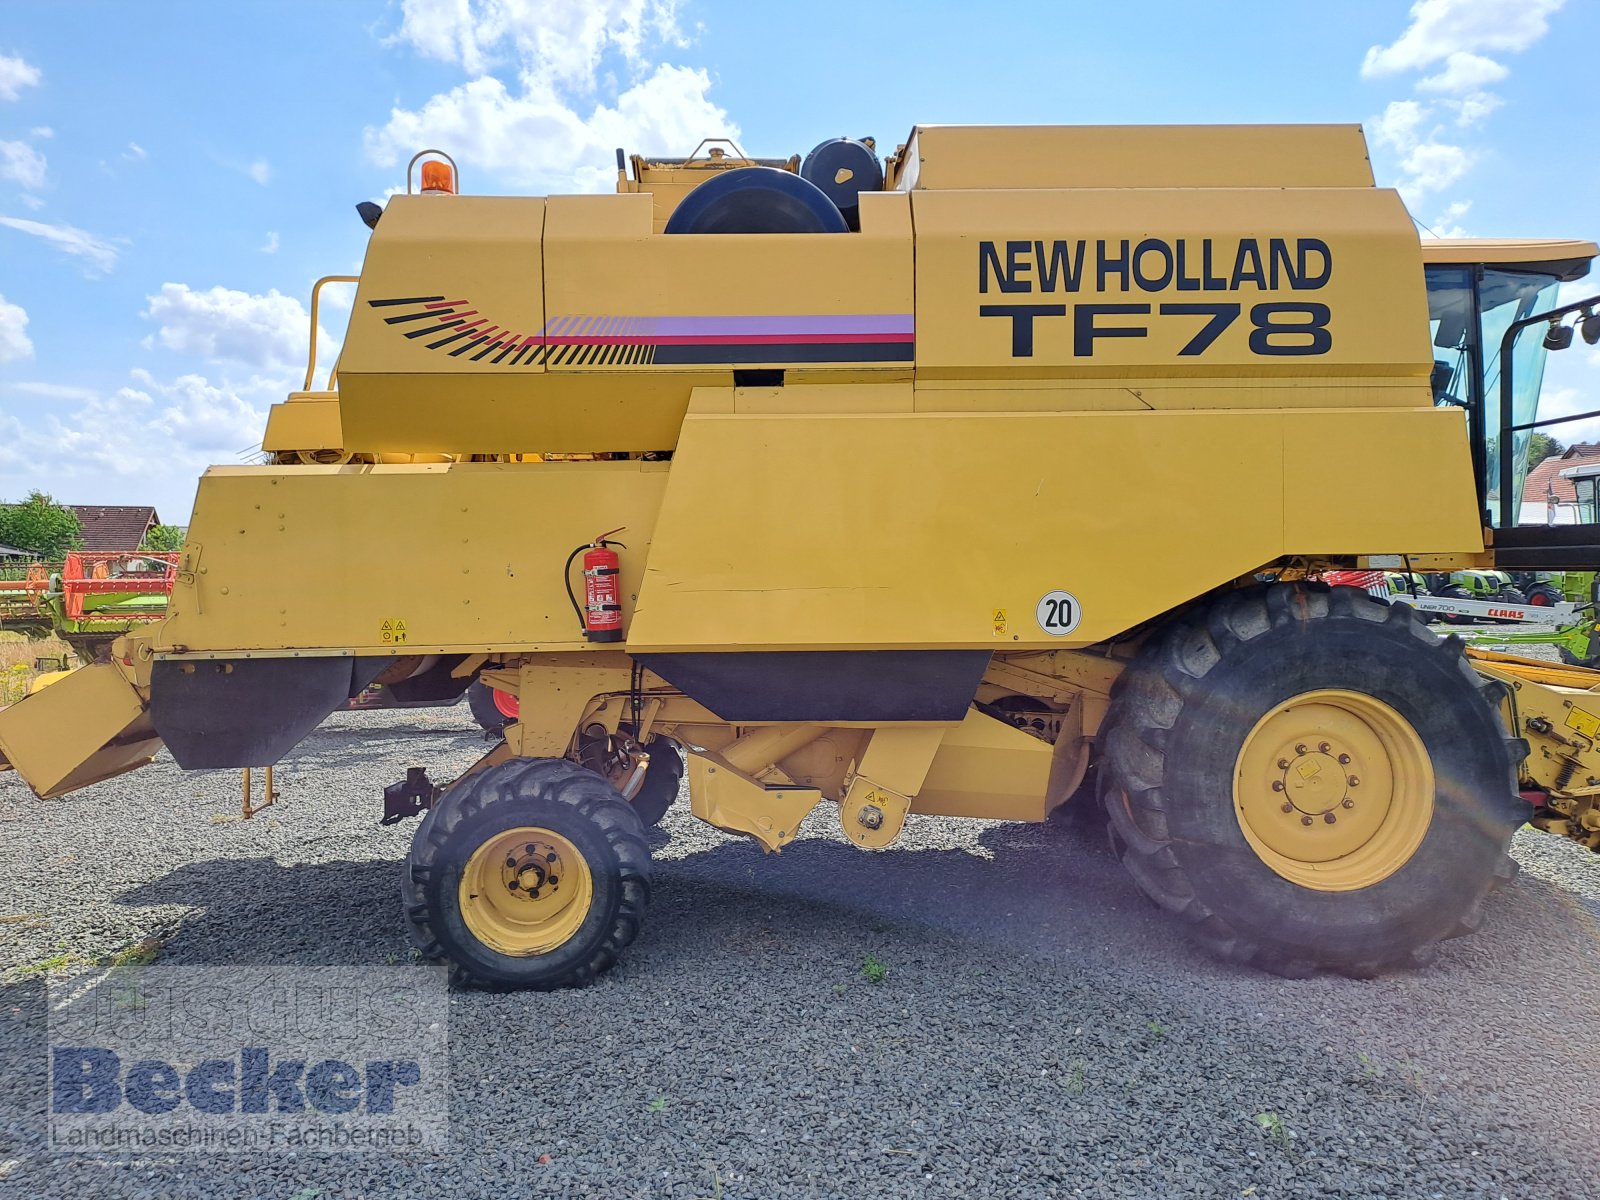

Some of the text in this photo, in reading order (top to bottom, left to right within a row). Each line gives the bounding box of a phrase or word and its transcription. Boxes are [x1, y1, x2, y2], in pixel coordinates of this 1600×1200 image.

[979, 238, 1333, 293] NEW HOLLAND
[979, 302, 1333, 357] TF78
[1045, 599, 1072, 628] 20
[1487, 608, 1525, 619] CLAAS
